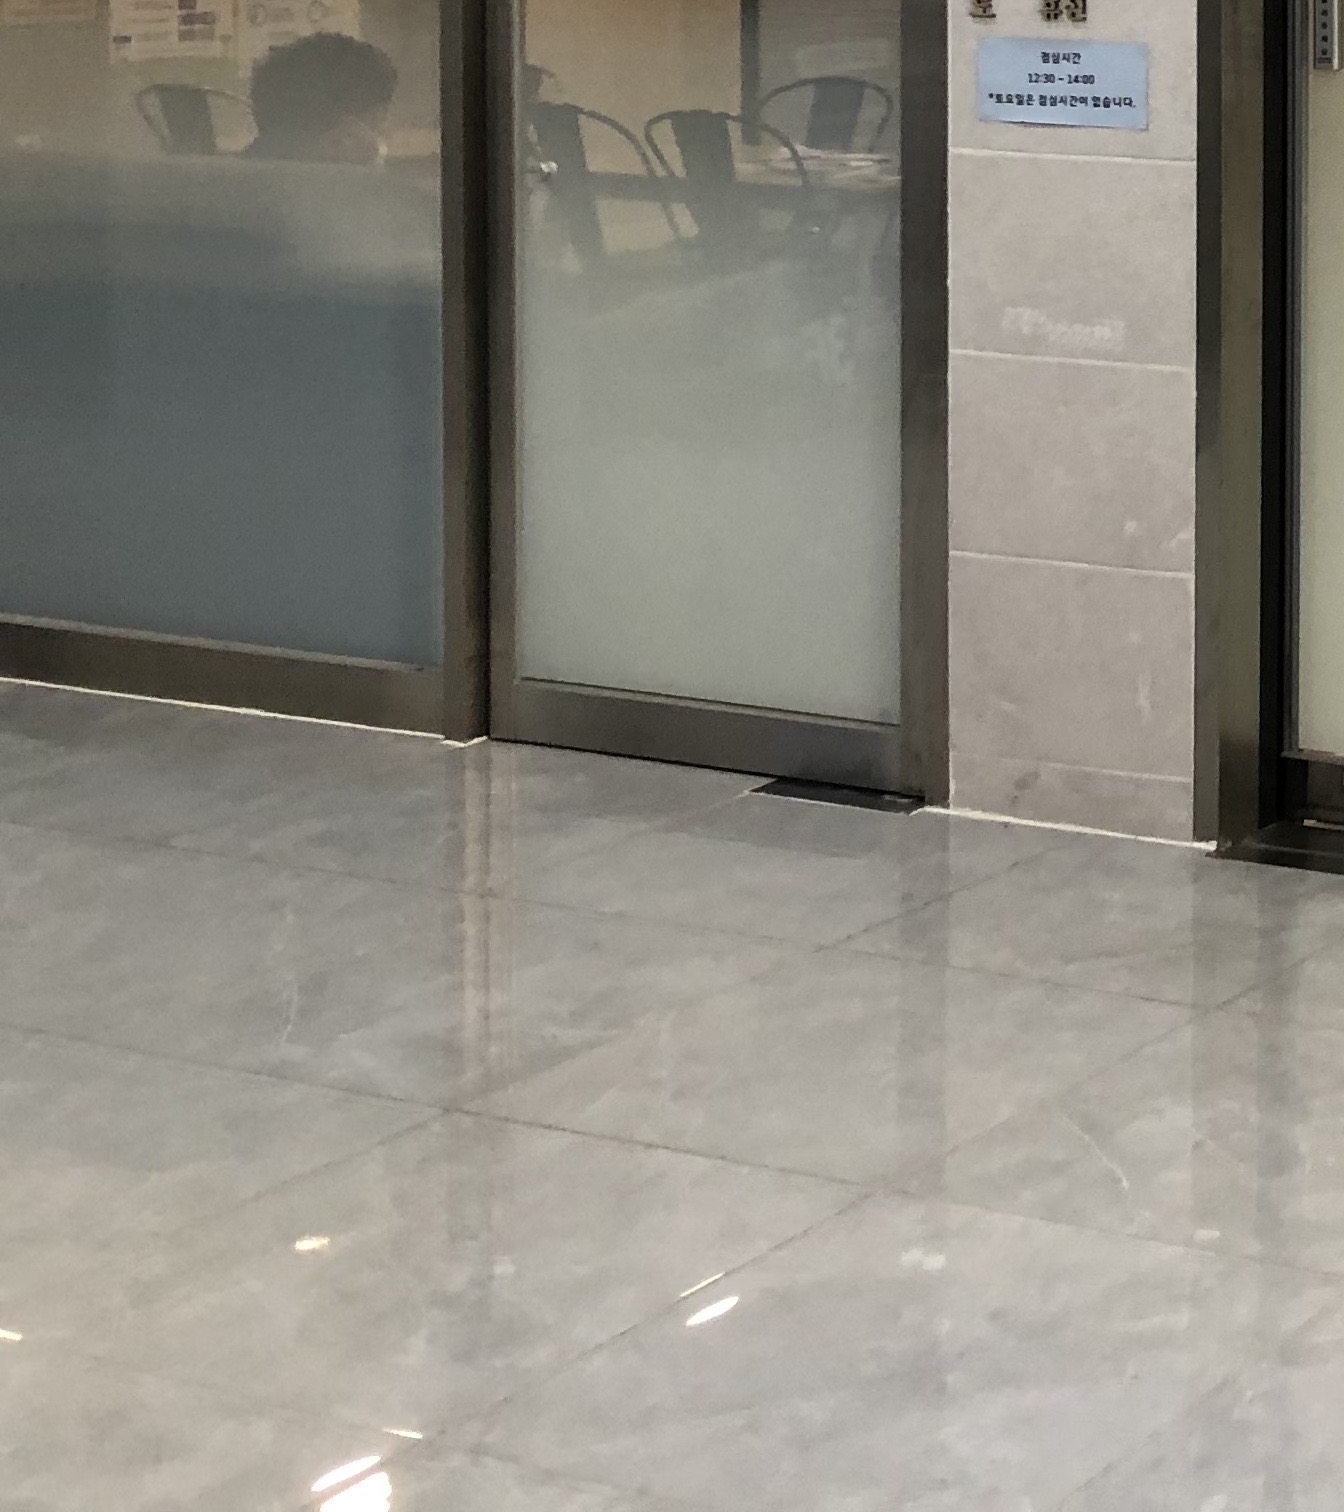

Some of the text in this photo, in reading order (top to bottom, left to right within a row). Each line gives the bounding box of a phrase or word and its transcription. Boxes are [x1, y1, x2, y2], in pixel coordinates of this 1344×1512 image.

[1041, 52, 1081, 64] 점심시간
[1028, 73, 1095, 84] 12:30 14:00
